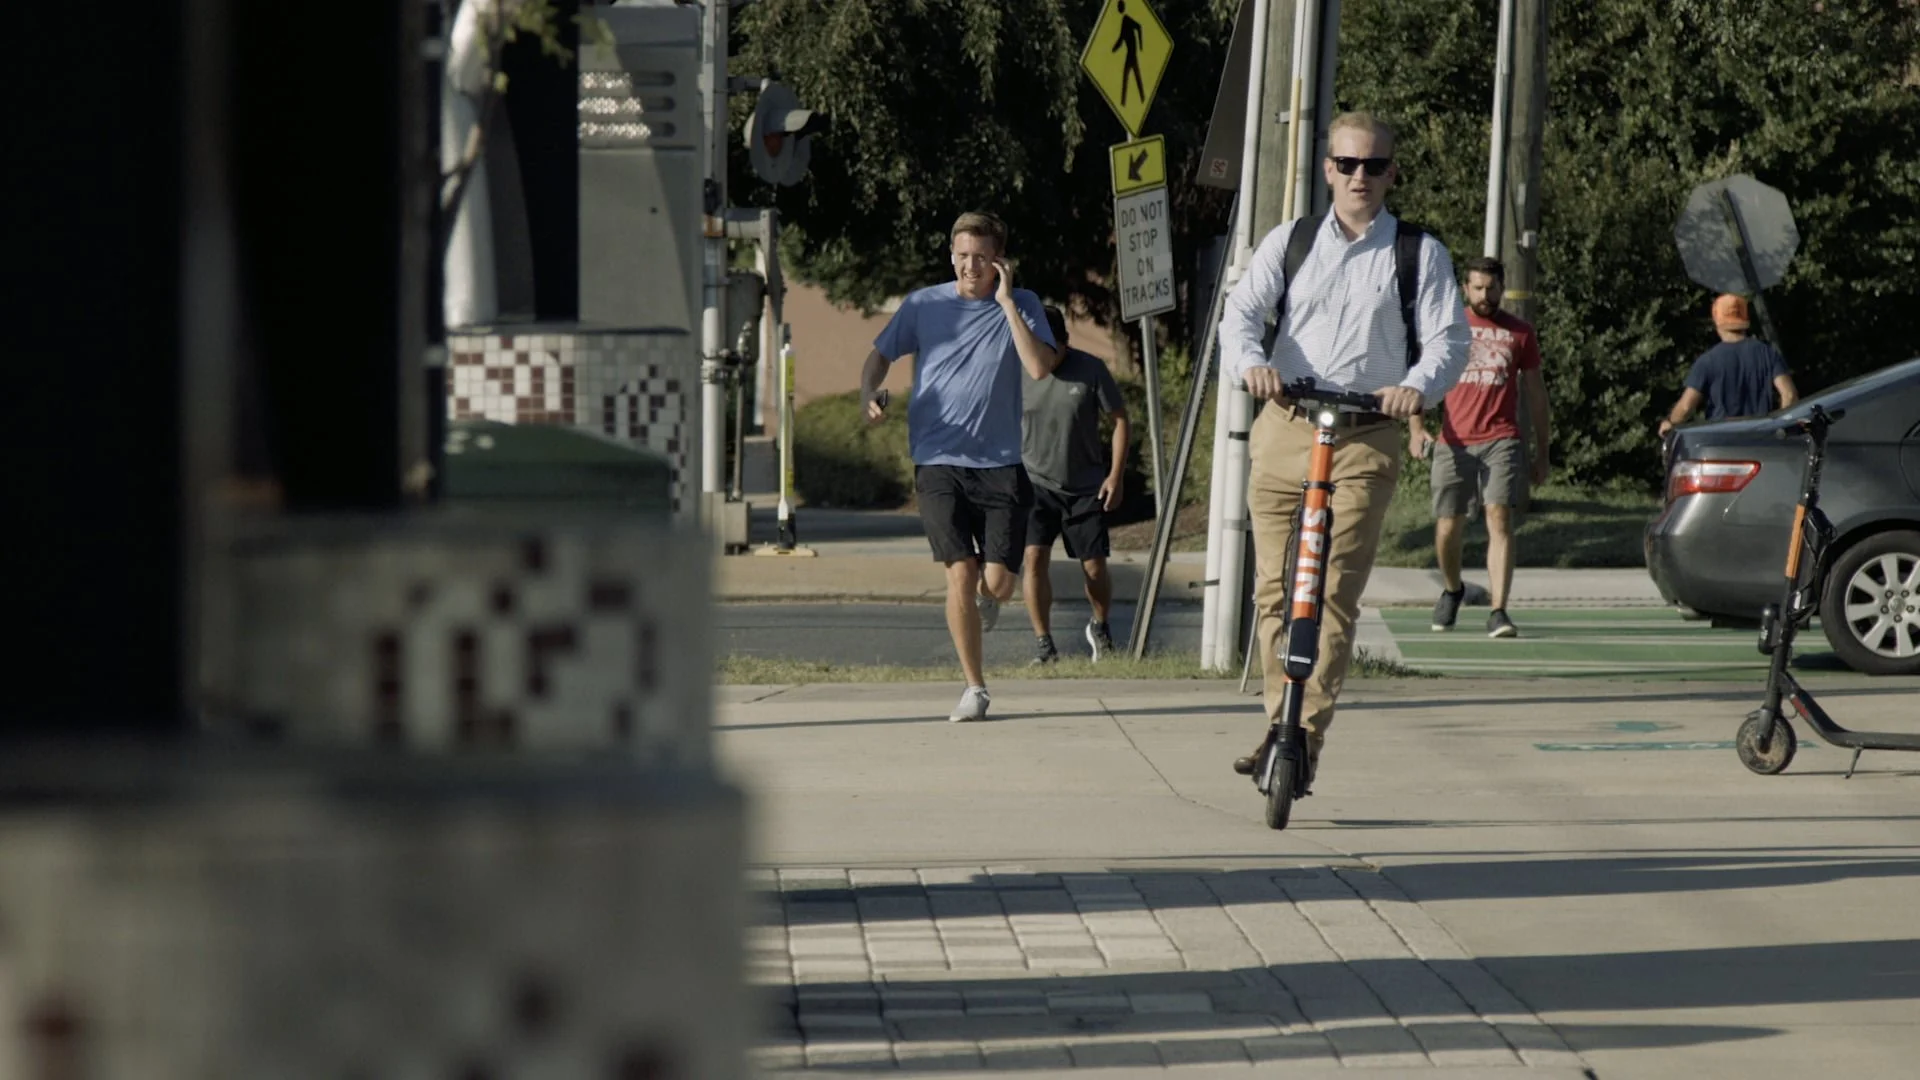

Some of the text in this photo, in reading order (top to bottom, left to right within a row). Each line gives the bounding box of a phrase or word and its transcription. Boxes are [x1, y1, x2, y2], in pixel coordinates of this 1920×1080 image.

[1121, 200, 1163, 228] DO NOT
[1129, 228, 1158, 251] STOP
[1137, 255, 1155, 276] ON
[1124, 278, 1170, 305] TRACKS
[1470, 326, 1514, 342] TAR
[1294, 507, 1326, 604] SPIN
